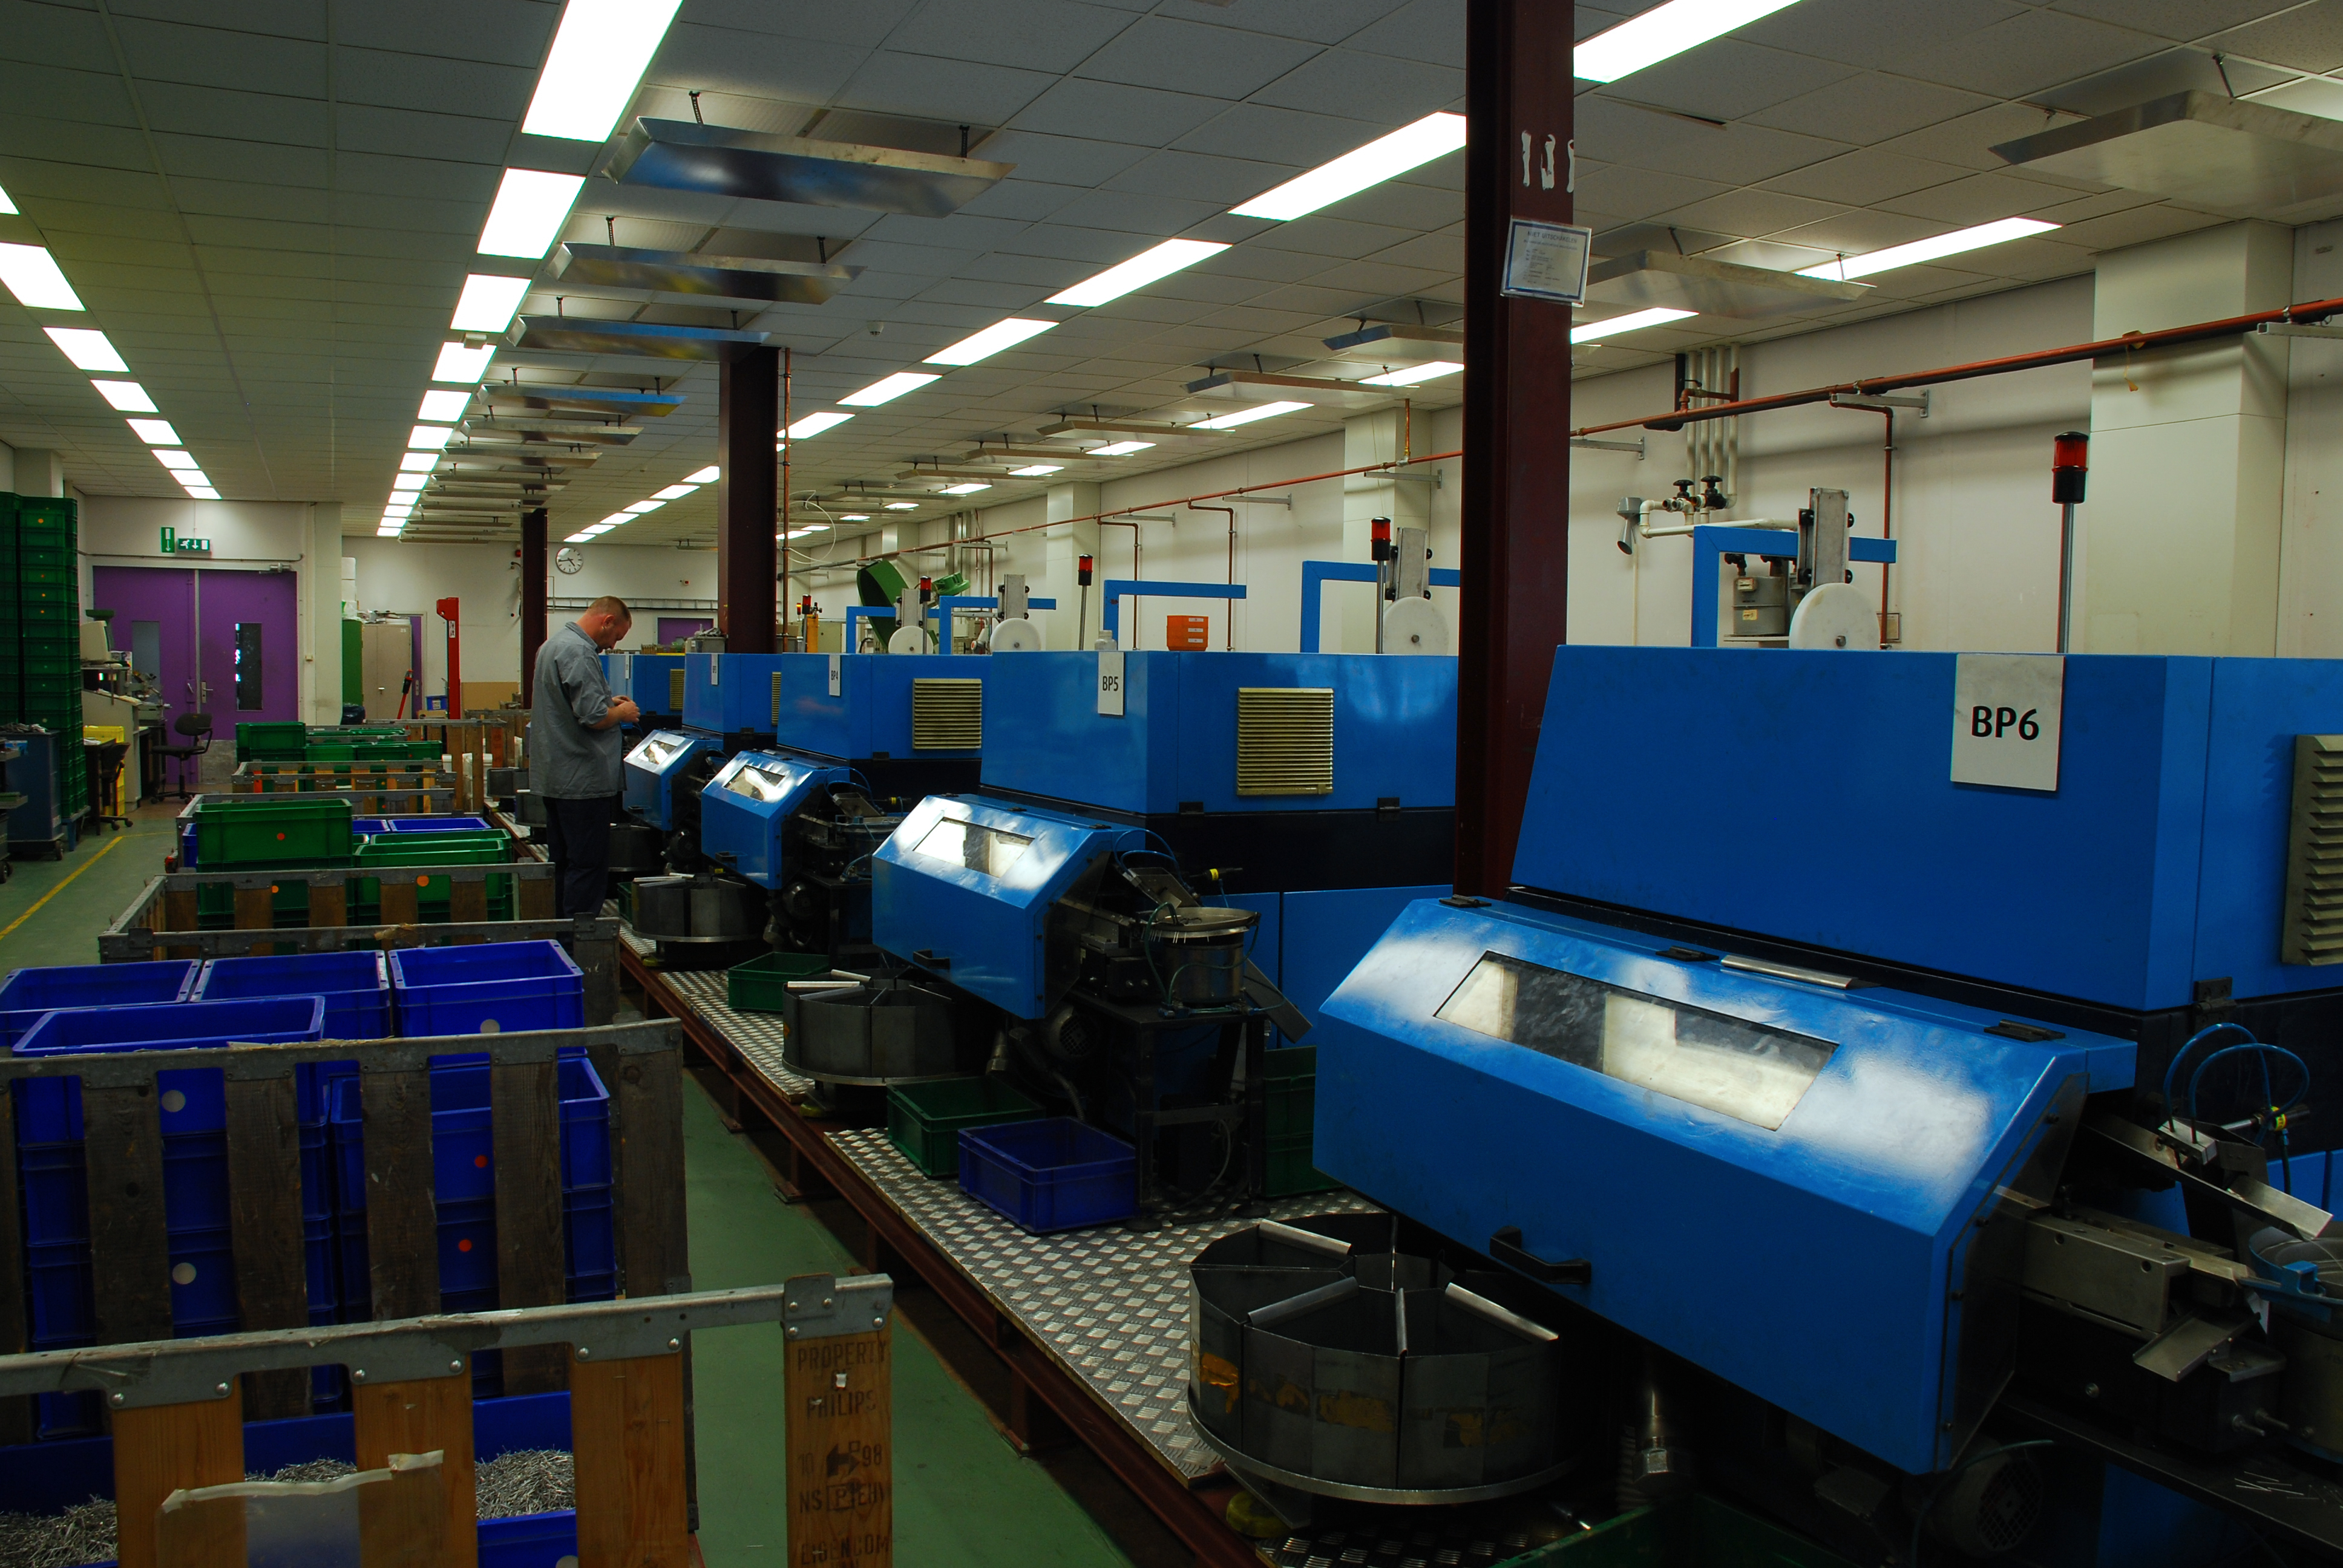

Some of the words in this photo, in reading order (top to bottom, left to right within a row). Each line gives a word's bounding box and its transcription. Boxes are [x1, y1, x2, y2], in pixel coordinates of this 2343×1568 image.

[1102, 675, 1119, 691] BP5
[1971, 705, 2039, 740] BP6
[798, 1339, 886, 1371] PROPERTY
[807, 1390, 876, 1419] PHILIPS
[862, 1443, 882, 1467] 98
